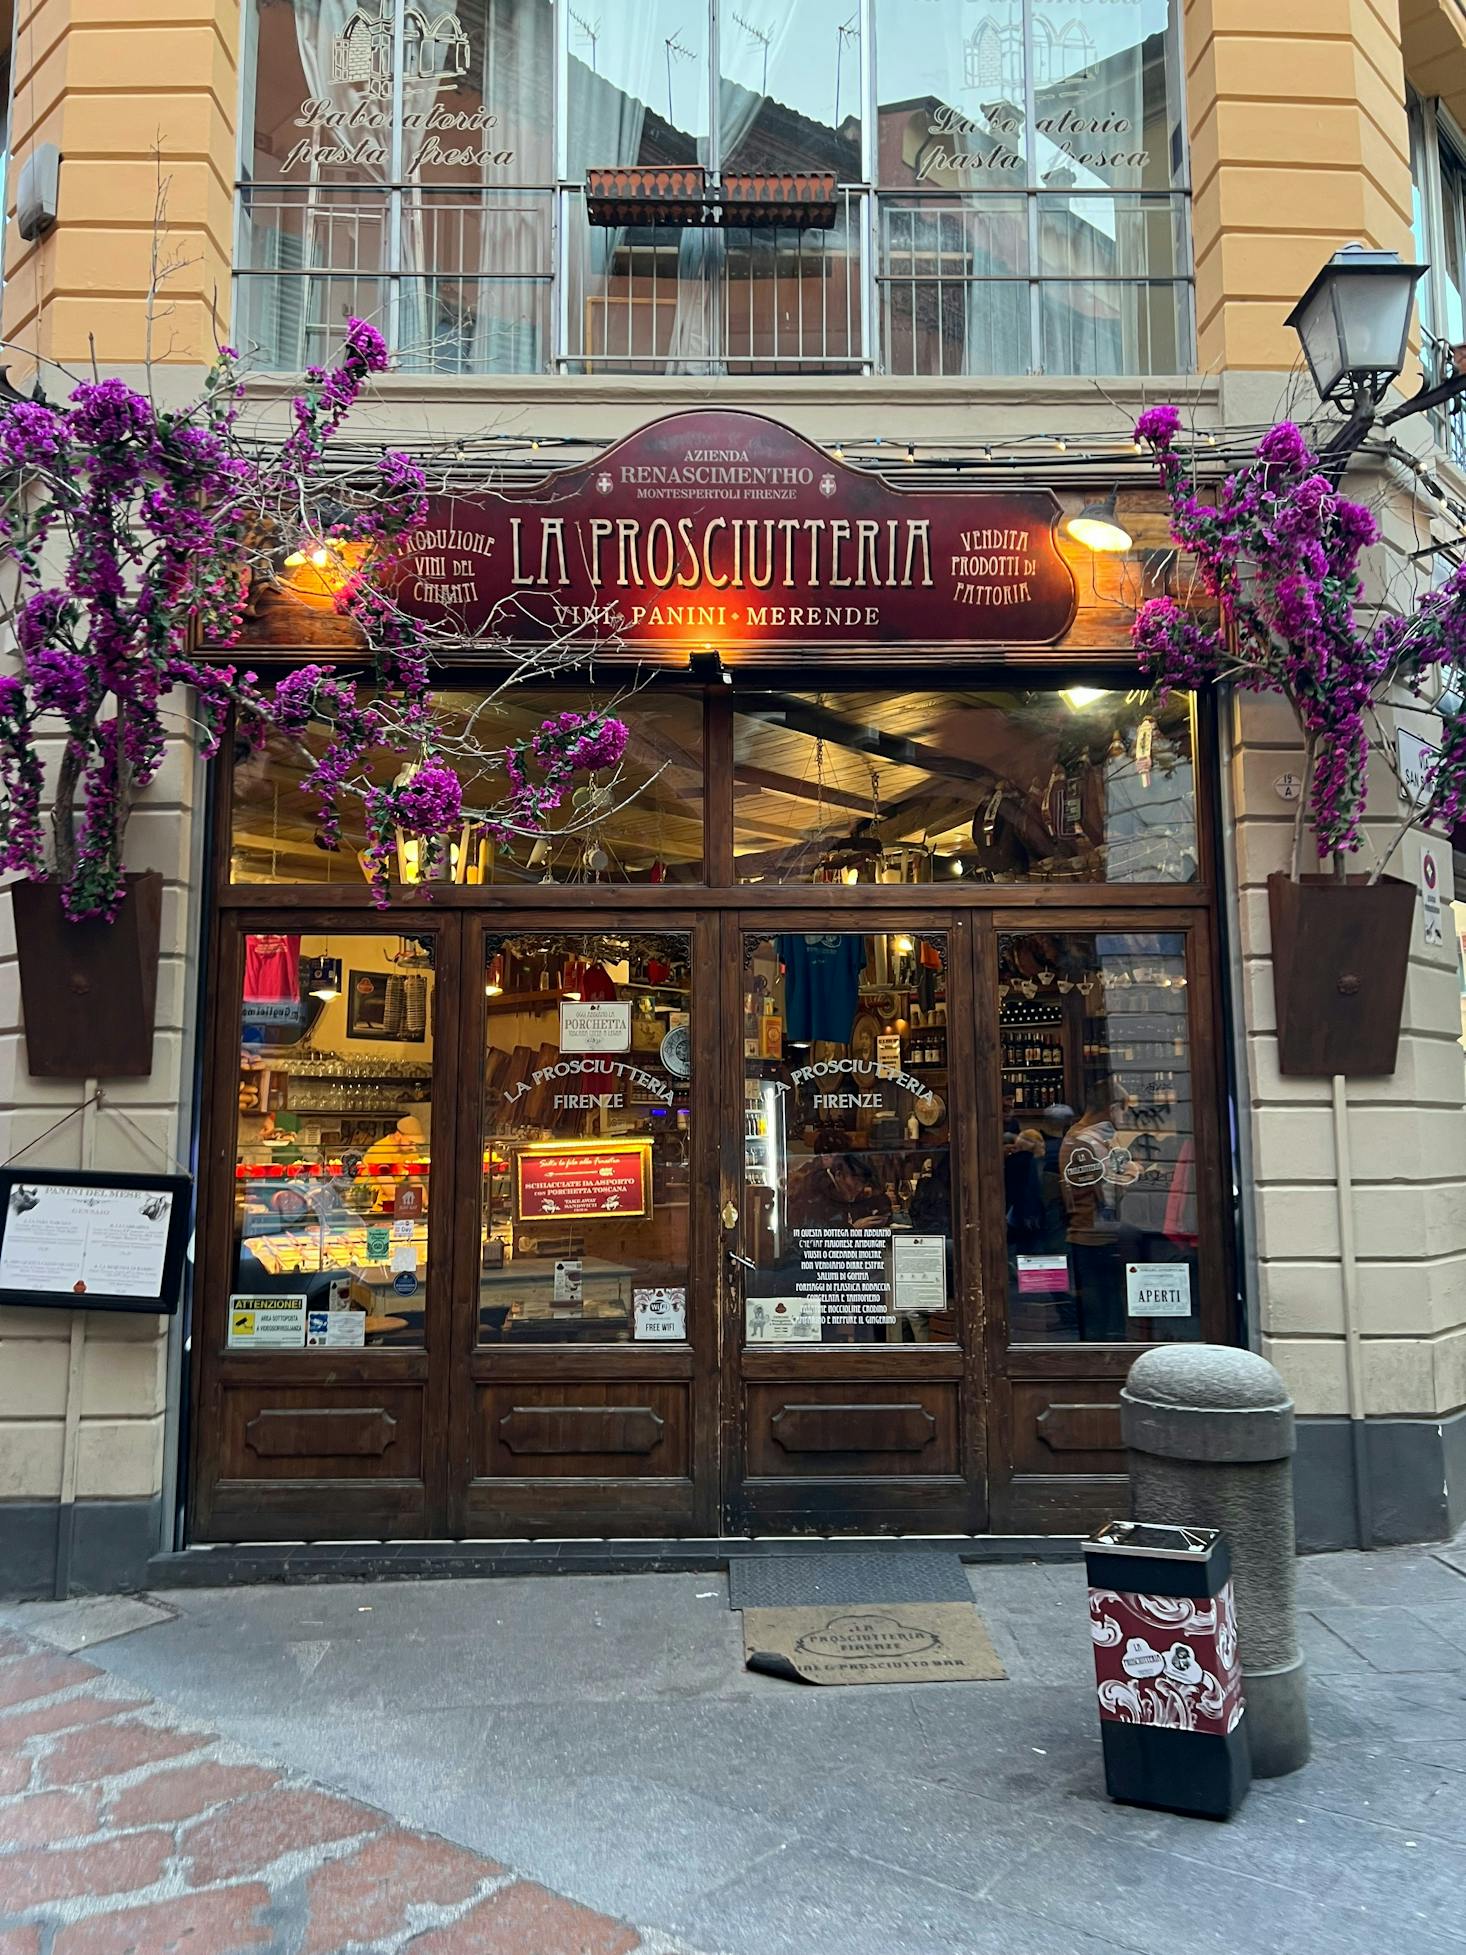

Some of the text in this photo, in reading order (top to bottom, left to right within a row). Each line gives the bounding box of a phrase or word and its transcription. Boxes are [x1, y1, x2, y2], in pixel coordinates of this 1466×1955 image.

[294, 98, 499, 131] Laboatorio
[928, 104, 1133, 135] Laboatorio
[281, 135, 515, 177] pasta fresca
[916, 144, 1022, 181] pasta
[684, 450, 749, 463] AZIENDA
[620, 466, 814, 485] RENASCIMENTHO
[636, 488, 798, 500] MONTESPERTOLI FIRENZE
[960, 529, 1029, 552] VENDITA
[510, 516, 934, 588] LA PROSCIUTTERIA
[414, 556, 475, 577] VINI DEL
[951, 556, 1036, 576] PRODOTTI DI
[413, 582, 479, 605] CHIANTI
[552, 605, 881, 626] VINI PANINI MERENDE
[1285, 786, 1292, 796] A
[564, 1018, 627, 1030] PORCHETTA
[503, 1059, 675, 1108] LA PROSCIUTTERIA
[790, 1059, 934, 1107] PROSCIUTTERIA
[553, 1093, 624, 1110] FIRENZE
[813, 1093, 883, 1109] FIRENZE
[525, 1178, 635, 1190] SCHIACCIATE DA ASPORTO
[547, 1187, 592, 1196] PORCHETTA
[592, 1185, 628, 1194] TOSCANA
[45, 1186, 84, 1196] PANINI
[793, 1228, 800, 1238] IN
[800, 1228, 823, 1238] QUESTA
[823, 1228, 849, 1238] BOTTEGA
[850, 1228, 863, 1238] NON
[801, 1261, 814, 1270] NON
[814, 1261, 846, 1270] VENDIAMO
[839, 1271, 847, 1281] DI
[795, 1282, 825, 1292] FORMAGGI
[825, 1282, 832, 1292] DI
[1138, 1289, 1181, 1303] APERTI
[234, 1299, 302, 1310] ATTENZIONE!
[645, 1322, 675, 1332] FREE WIFI
[840, 1642, 902, 1651] FIRENZE
[1133, 1643, 1143, 1653] LA
[838, 1660, 929, 1670] PROSCIUTTO
